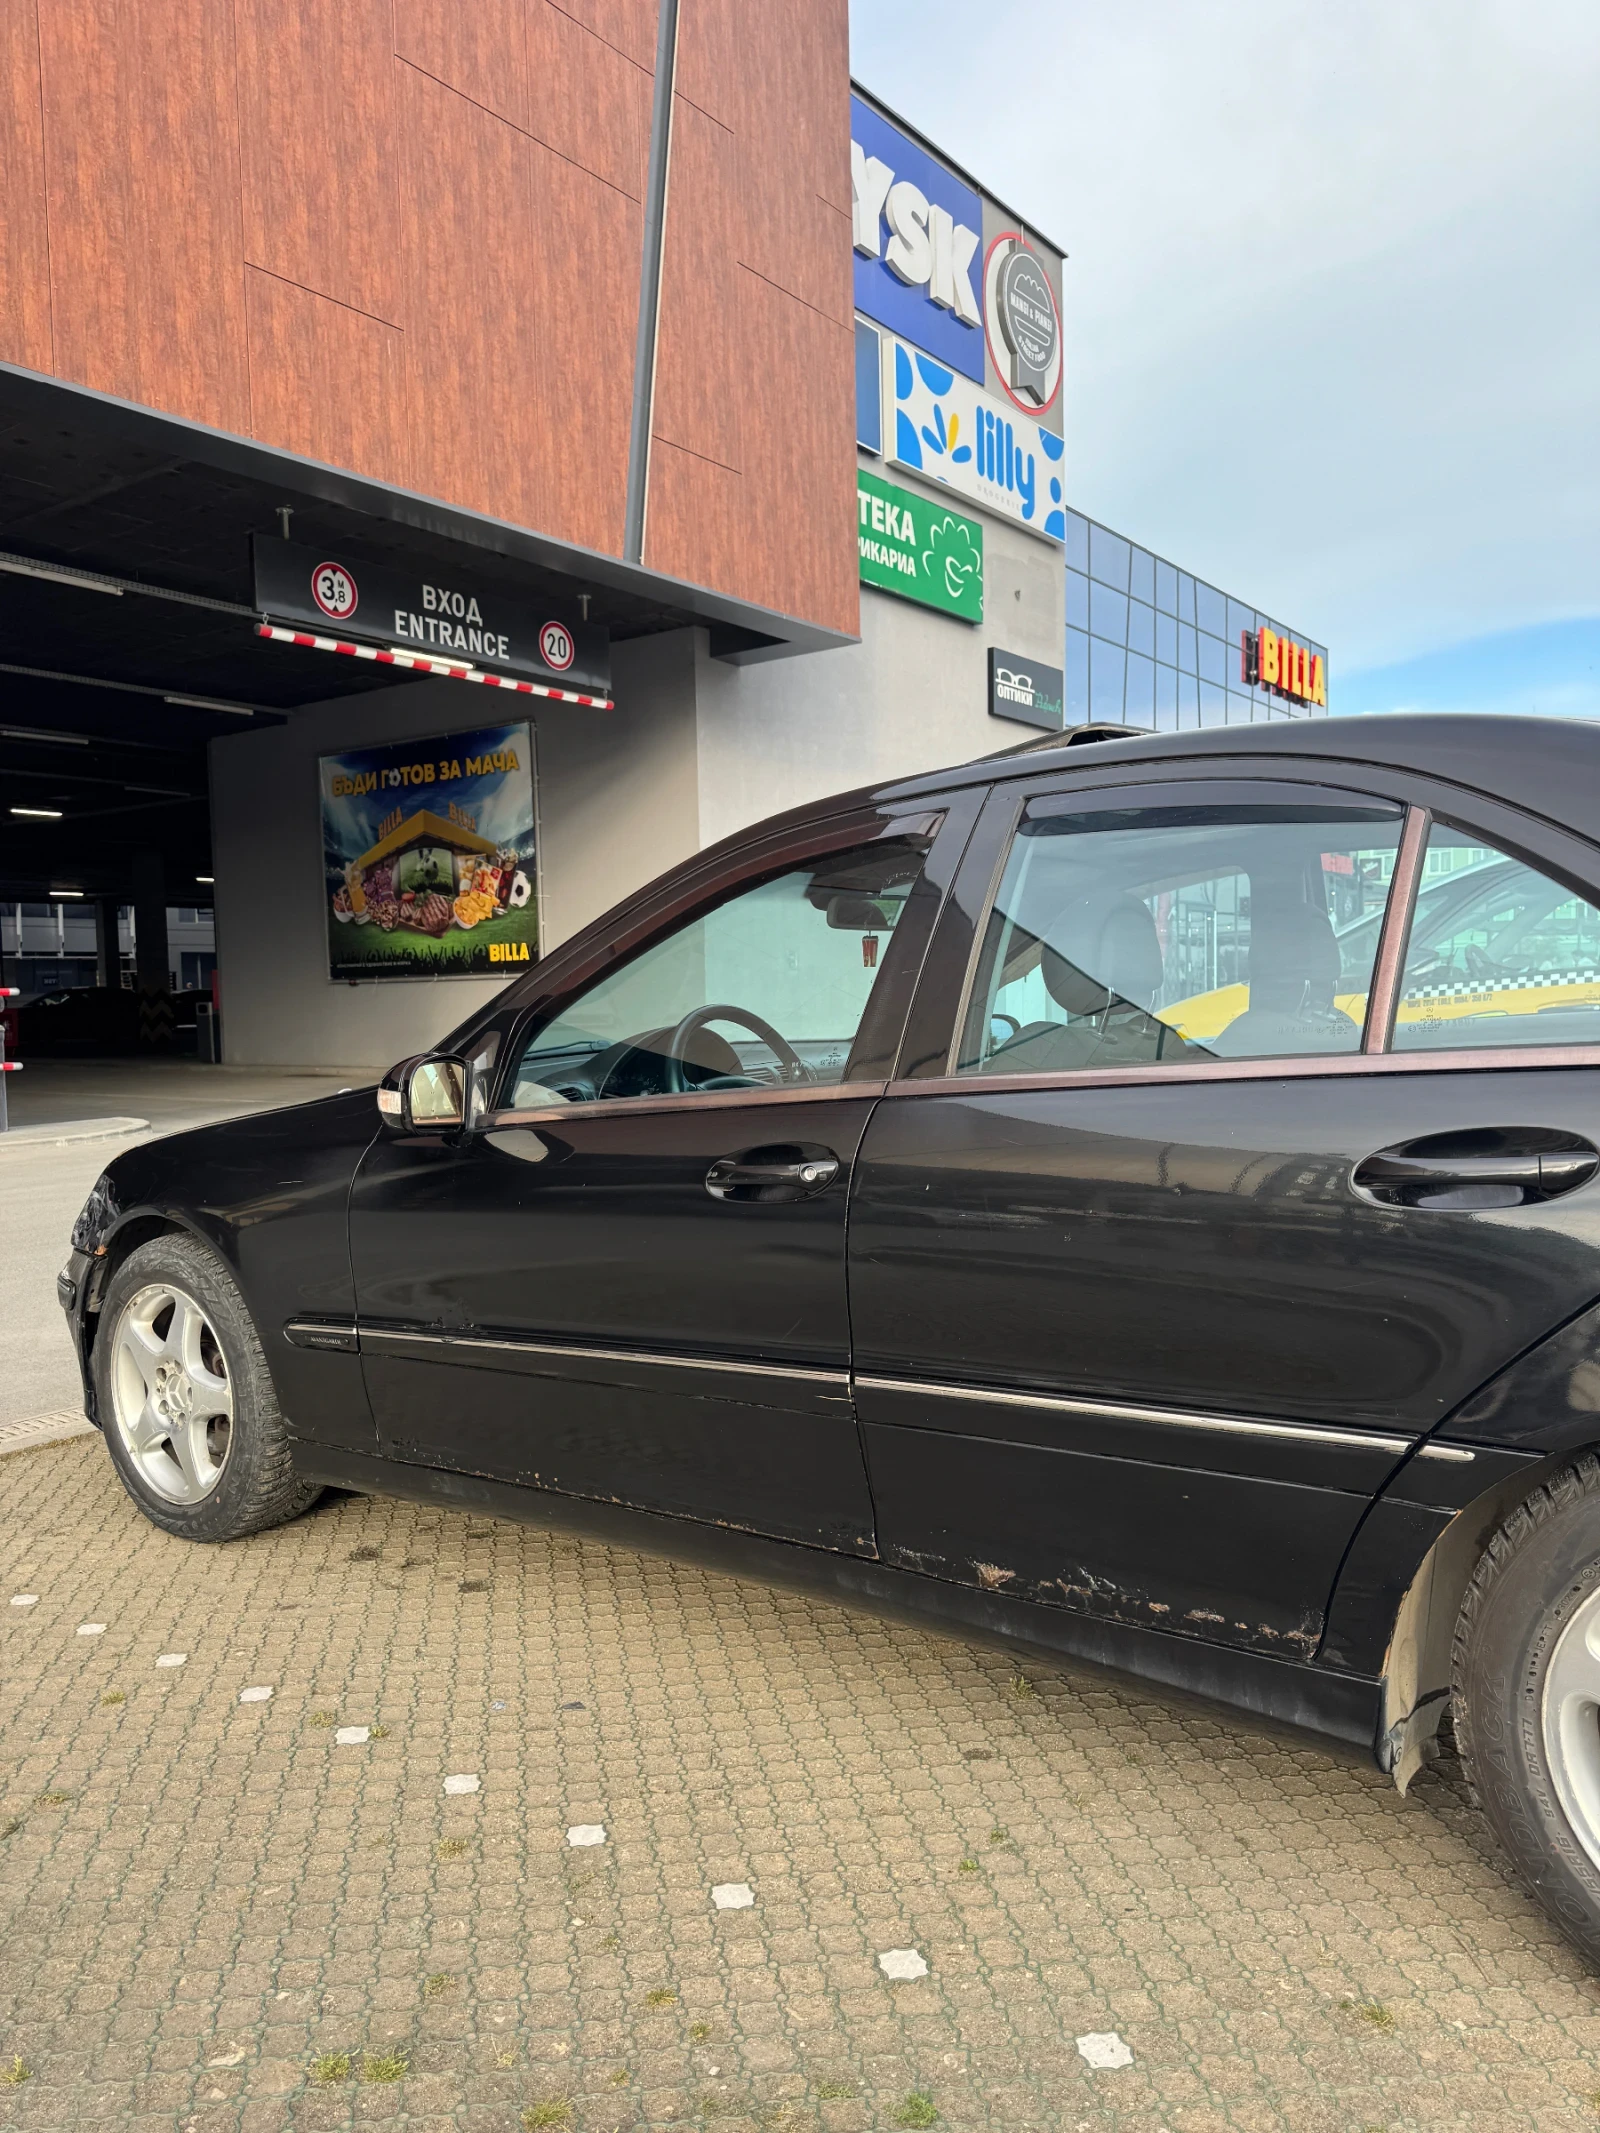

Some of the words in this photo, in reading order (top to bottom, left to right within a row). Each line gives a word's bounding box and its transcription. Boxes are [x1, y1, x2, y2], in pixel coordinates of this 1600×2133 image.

[1010, 292, 1029, 316] MANGI
[976, 405, 1035, 520] lilly
[858, 536, 917, 578] ИКАРИА
[422, 584, 483, 627] ВХОД
[394, 609, 510, 660] ENTRANCE
[547, 633, 567, 658] 20
[1258, 626, 1325, 707] BILLA
[997, 684, 1033, 707] ОПТИКИ
[332, 771, 378, 797] БЪДИ
[439, 759, 462, 780] ЗА
[465, 751, 519, 777] МАЧА
[378, 806, 403, 841] BILLA
[489, 942, 530, 962] BILLA
